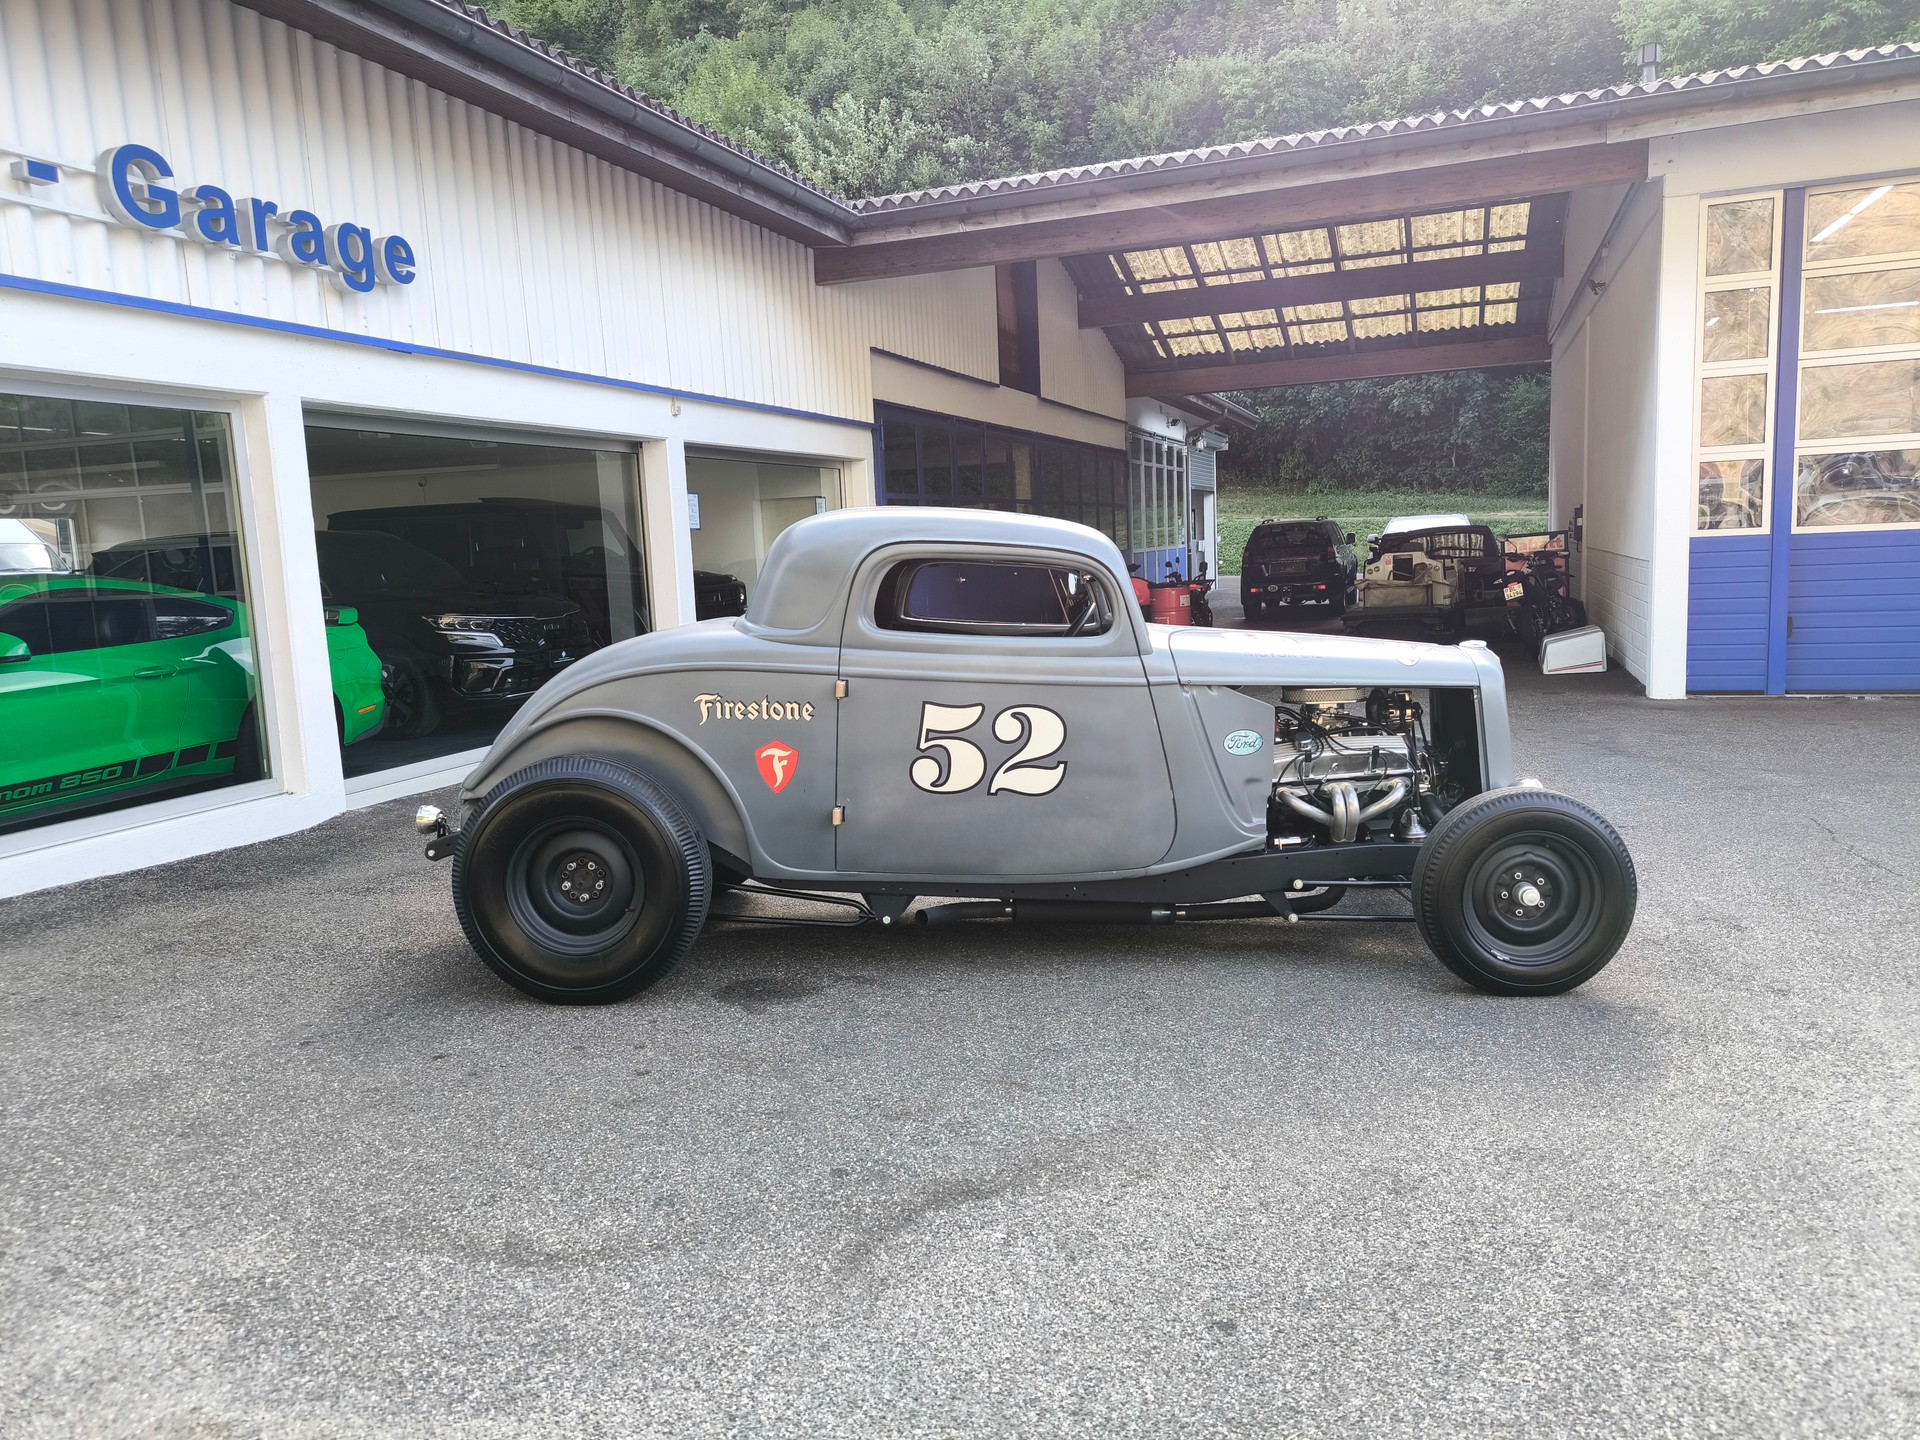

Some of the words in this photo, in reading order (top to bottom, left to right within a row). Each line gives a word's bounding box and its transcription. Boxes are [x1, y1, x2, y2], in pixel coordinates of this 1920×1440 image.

[103, 143, 417, 294] Garage
[693, 692, 816, 726] Firestone
[909, 700, 1068, 797] 52
[1227, 734, 1259, 750] Ford
[59, 765, 123, 789] 850
[760, 747, 793, 788] F
